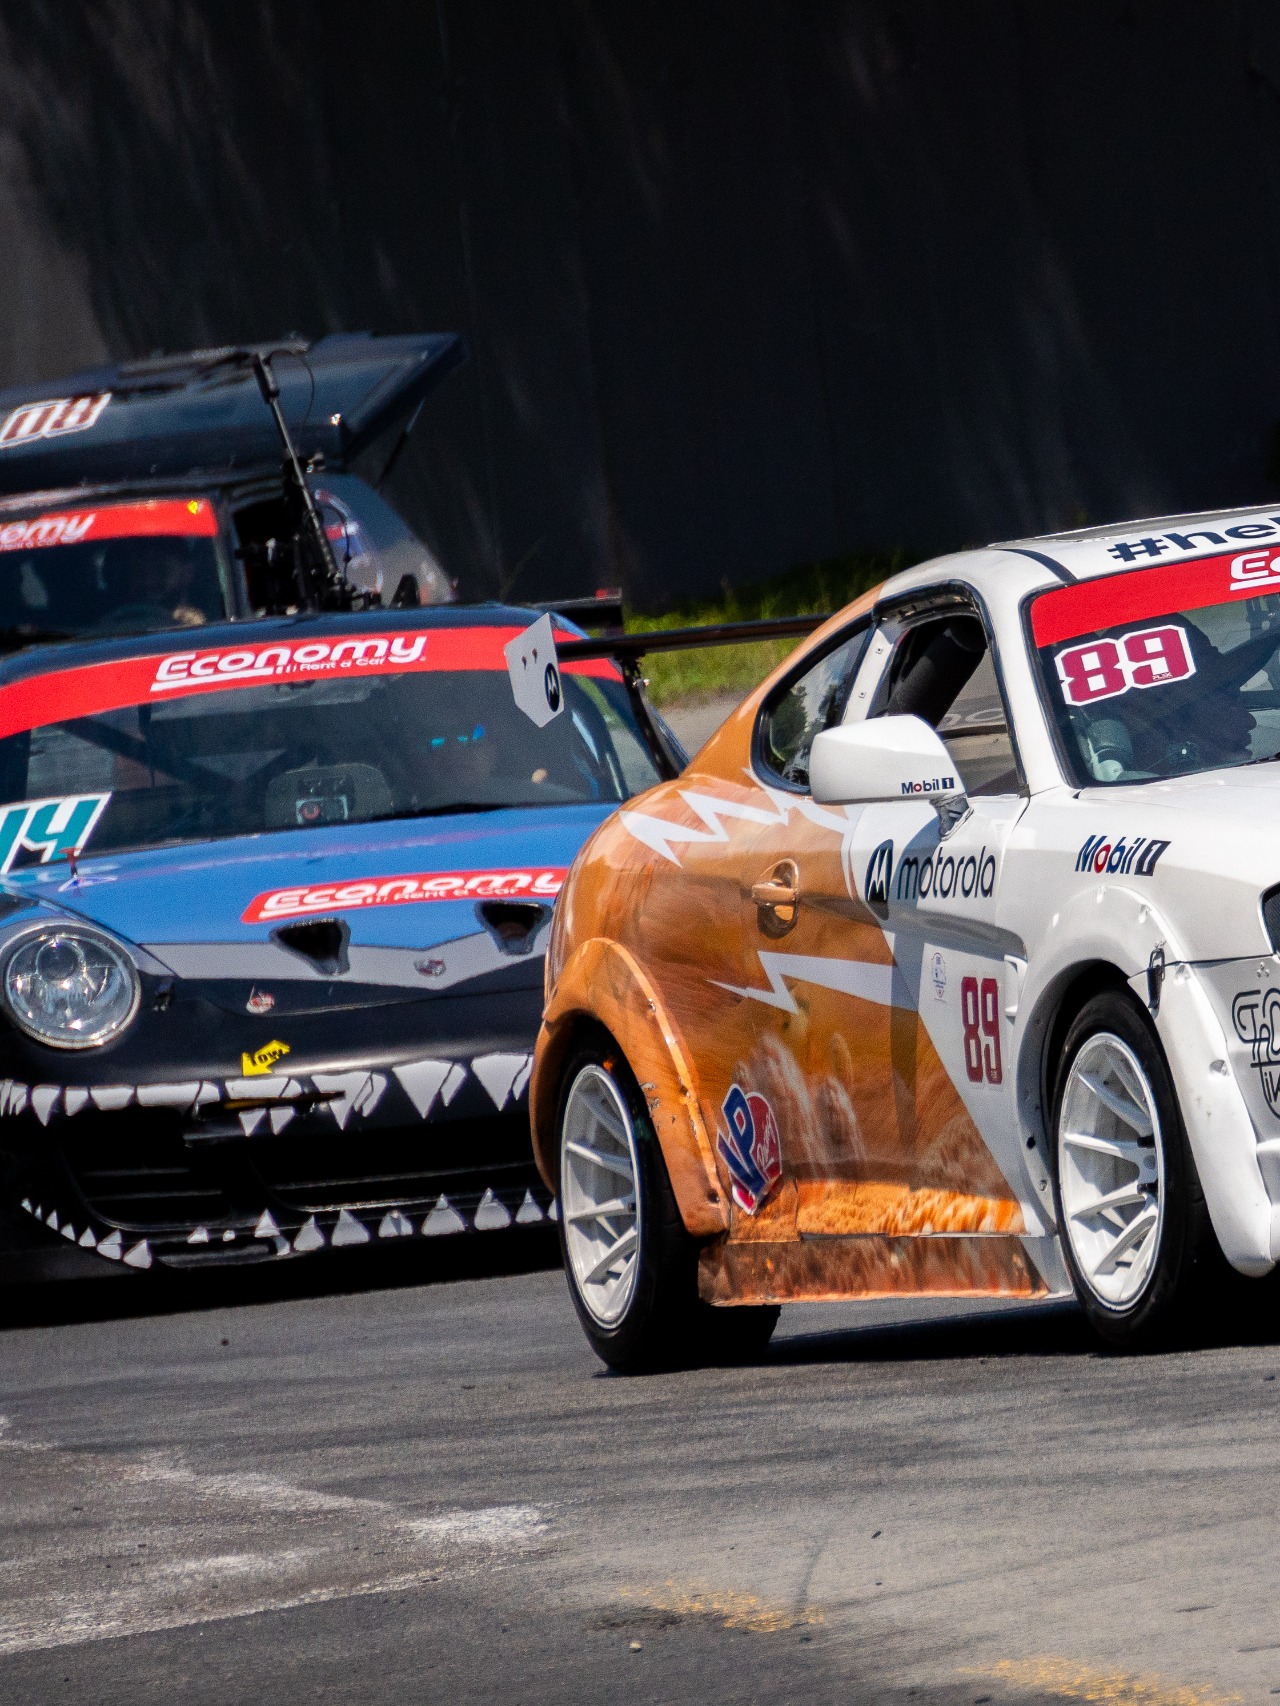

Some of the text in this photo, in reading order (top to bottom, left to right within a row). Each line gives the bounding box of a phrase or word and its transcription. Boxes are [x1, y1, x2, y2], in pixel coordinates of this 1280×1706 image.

[155, 636, 428, 682] Economy
[300, 662, 336, 671] Rent
[356, 656, 385, 666] Car
[1056, 625, 1195, 706] 89
[901, 777, 954, 794] Mobil 1
[897, 846, 996, 900] motorola
[1074, 834, 1168, 875] Mobil 1
[960, 976, 1003, 1085] 89
